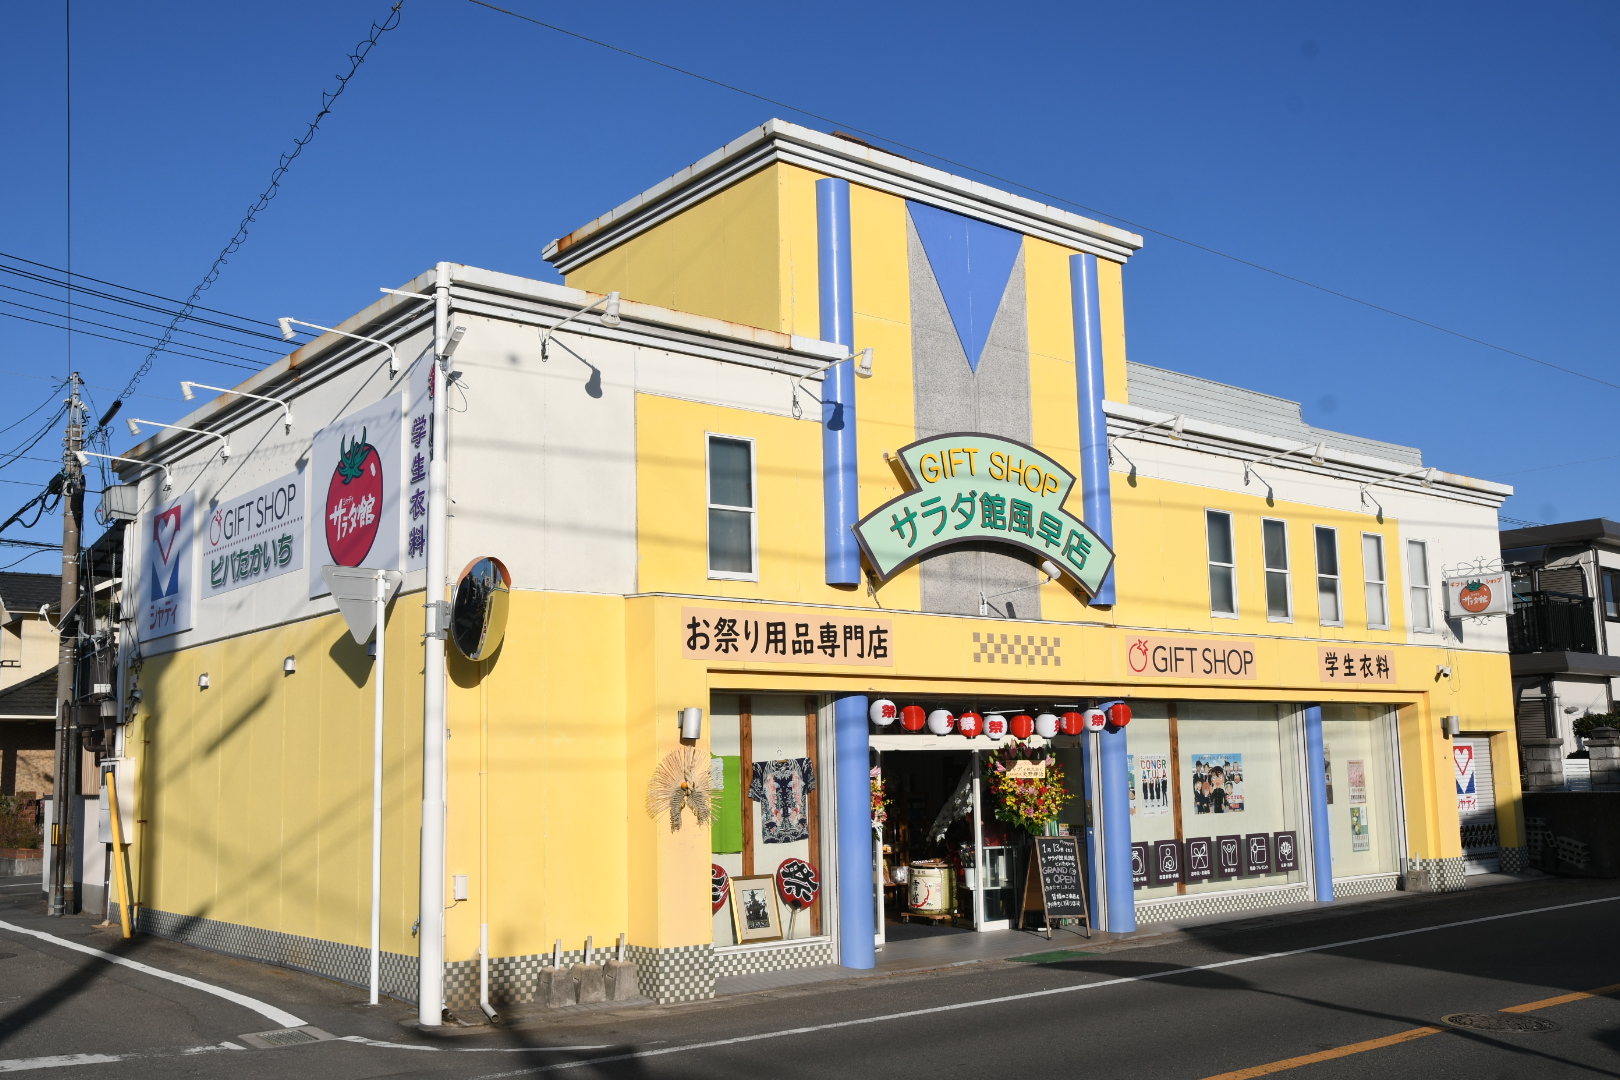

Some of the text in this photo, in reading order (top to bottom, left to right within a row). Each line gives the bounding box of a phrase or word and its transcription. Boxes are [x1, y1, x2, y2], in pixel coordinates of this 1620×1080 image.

[408, 414, 426, 558] 学生衣料
[920, 448, 1060, 497] GIFT SHOP
[223, 483, 296, 540] GIFT SHOP
[329, 493, 375, 541] サラダ館
[890, 490, 1093, 571] サラダ館風早店
[211, 533, 294, 588] ビバたかいち
[149, 599, 178, 630] シャディ
[686, 616, 888, 659] お祭り用品専門店
[1152, 645, 1254, 675] GIFT SHOP
[1325, 651, 1390, 679] 学生衣料
[881, 704, 896, 719] 祭
[960, 716, 976, 731] 祭
[1091, 714, 1104, 727] 祭
[988, 720, 1004, 734] 祭
[1140, 759, 1167, 769] CONGR
[1142, 770, 1168, 779] ATULA
[1042, 867, 1068, 875] GRAND
[1053, 874, 1076, 884] OPEN
